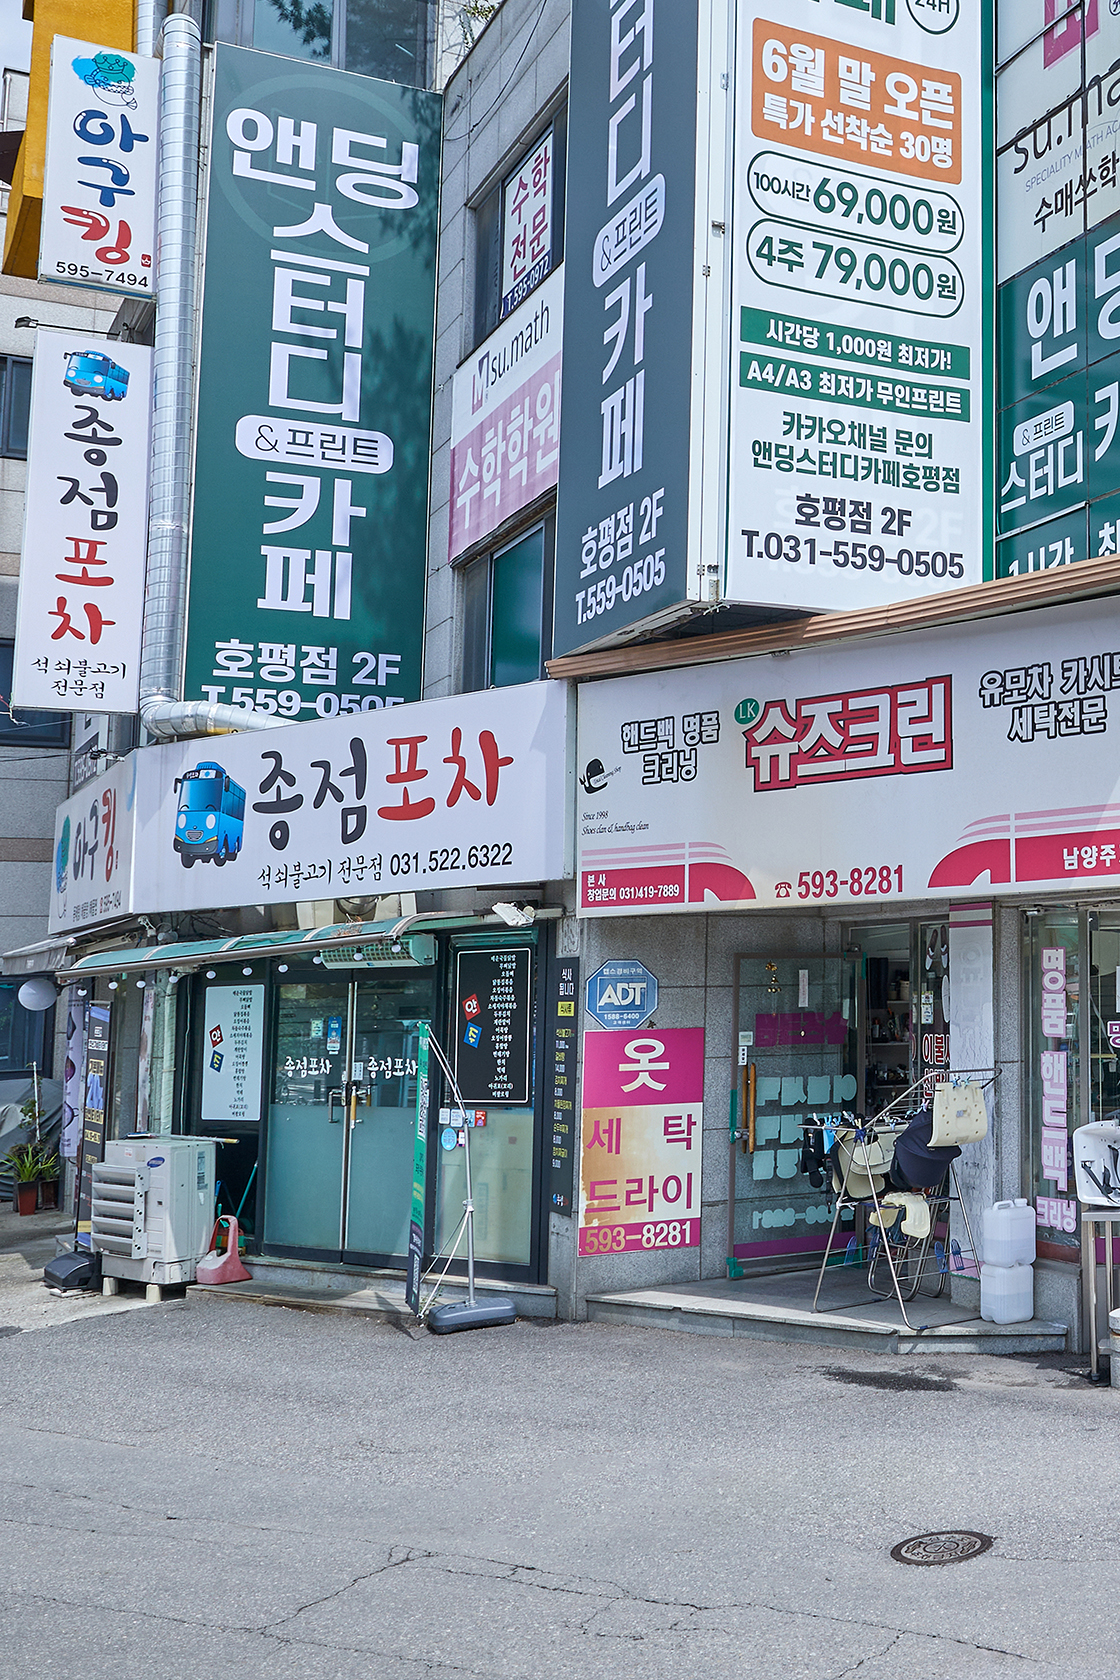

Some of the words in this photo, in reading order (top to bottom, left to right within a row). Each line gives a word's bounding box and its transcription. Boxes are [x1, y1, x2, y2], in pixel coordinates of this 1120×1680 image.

[761, 38, 825, 100] 6월
[837, 53, 876, 111] 말
[884, 70, 956, 130] 오픈
[761, 90, 814, 137] 특가
[819, 108, 894, 157] 선착순
[899, 131, 953, 170] 30명
[225, 107, 420, 210] 앤딩
[510, 144, 550, 221] 수학
[60, 108, 150, 266] 아구킹
[752, 170, 811, 203] 100시간
[812, 176, 958, 236] 69,000원
[509, 207, 549, 283] 전문
[613, 187, 659, 254] 프린트
[55, 260, 149, 289] 595-7494
[507, 255, 551, 313] T.595-0972
[754, 235, 805, 273] 4주
[812, 241, 958, 301] 79,000원
[268, 202, 371, 424] 스터디
[490, 299, 550, 388] su.math
[765, 318, 821, 350] 시간당
[825, 330, 893, 363] 1,000원
[897, 345, 953, 371] 최저가!
[598, 261, 653, 490] 카페
[746, 361, 812, 391] A4/A3
[818, 373, 873, 403] 최저가
[876, 381, 963, 415] 무인프린트
[254, 424, 279, 453] &
[284, 429, 380, 467] 프린트
[456, 368, 558, 530] 수학학원
[782, 410, 888, 452] 카카오채널
[894, 427, 934, 460] 문의
[1032, 411, 1066, 439] 프린트
[750, 439, 961, 495] 앤딩스터디카페호평점
[1000, 430, 1084, 514] 스터디
[48, 404, 123, 646] 종점포차
[580, 499, 634, 581] 호평점
[638, 486, 665, 545] 2F
[794, 492, 872, 535] 호평점
[880, 508, 912, 537] 2F
[256, 470, 368, 621] 카페
[741, 529, 965, 579] T.031-559-0505
[574, 547, 667, 626] T.559-0505
[50, 677, 106, 700] 전문점
[212, 638, 339, 688] 호평점
[351, 650, 402, 689] 2F
[979, 664, 1053, 709] 유모차
[621, 714, 676, 754] 핸드백
[681, 711, 721, 747] 명품
[748, 678, 950, 787] 슈즈크린
[1007, 700, 1108, 743] 세탁전문
[251, 726, 515, 852] 종점포차
[641, 749, 698, 786] 크리닝
[337, 852, 384, 882] 전문점
[389, 842, 513, 877] 031.522.6322
[797, 864, 905, 900] 593-8281
[587, 887, 617, 902] 창업문의
[619, 884, 681, 900] 031)419-7889
[598, 982, 647, 1006] ADT
[603, 1012, 640, 1020] 1588-6400
[283, 1055, 333, 1079] 종점포차
[366, 1055, 419, 1080] 종점포차
[618, 1037, 670, 1093] 옷
[584, 1172, 693, 1213] 드라이
[585, 1220, 692, 1255] 593-8281
